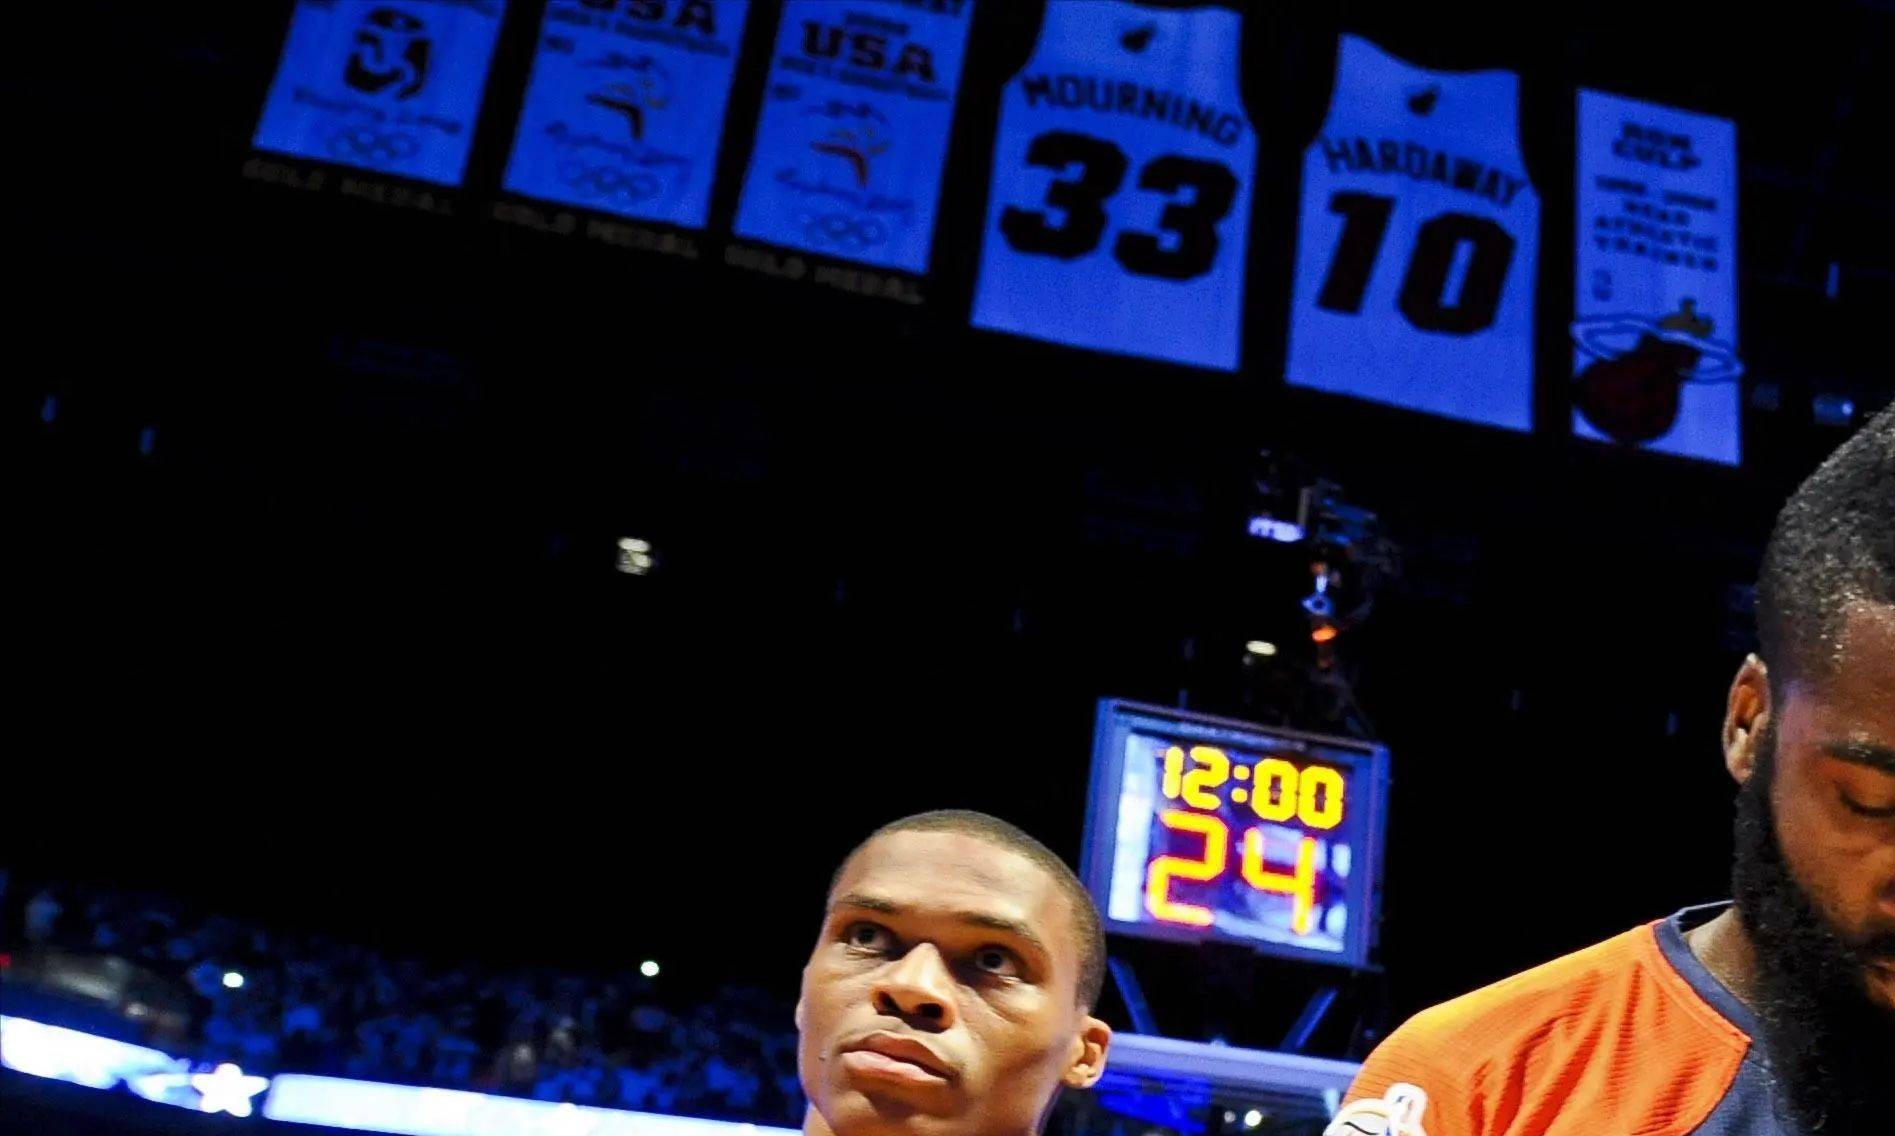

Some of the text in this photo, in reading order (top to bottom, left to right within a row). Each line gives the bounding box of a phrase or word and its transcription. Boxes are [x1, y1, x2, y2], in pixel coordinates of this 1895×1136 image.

[802, 21, 936, 83] USA
[1021, 73, 1245, 149] MOURNING
[999, 130, 1239, 282] 33
[1319, 136, 1527, 207] HARDAWAY
[1315, 190, 1518, 338] 10
[1162, 745, 1344, 830] 12:00
[1145, 808, 1319, 936] 24
